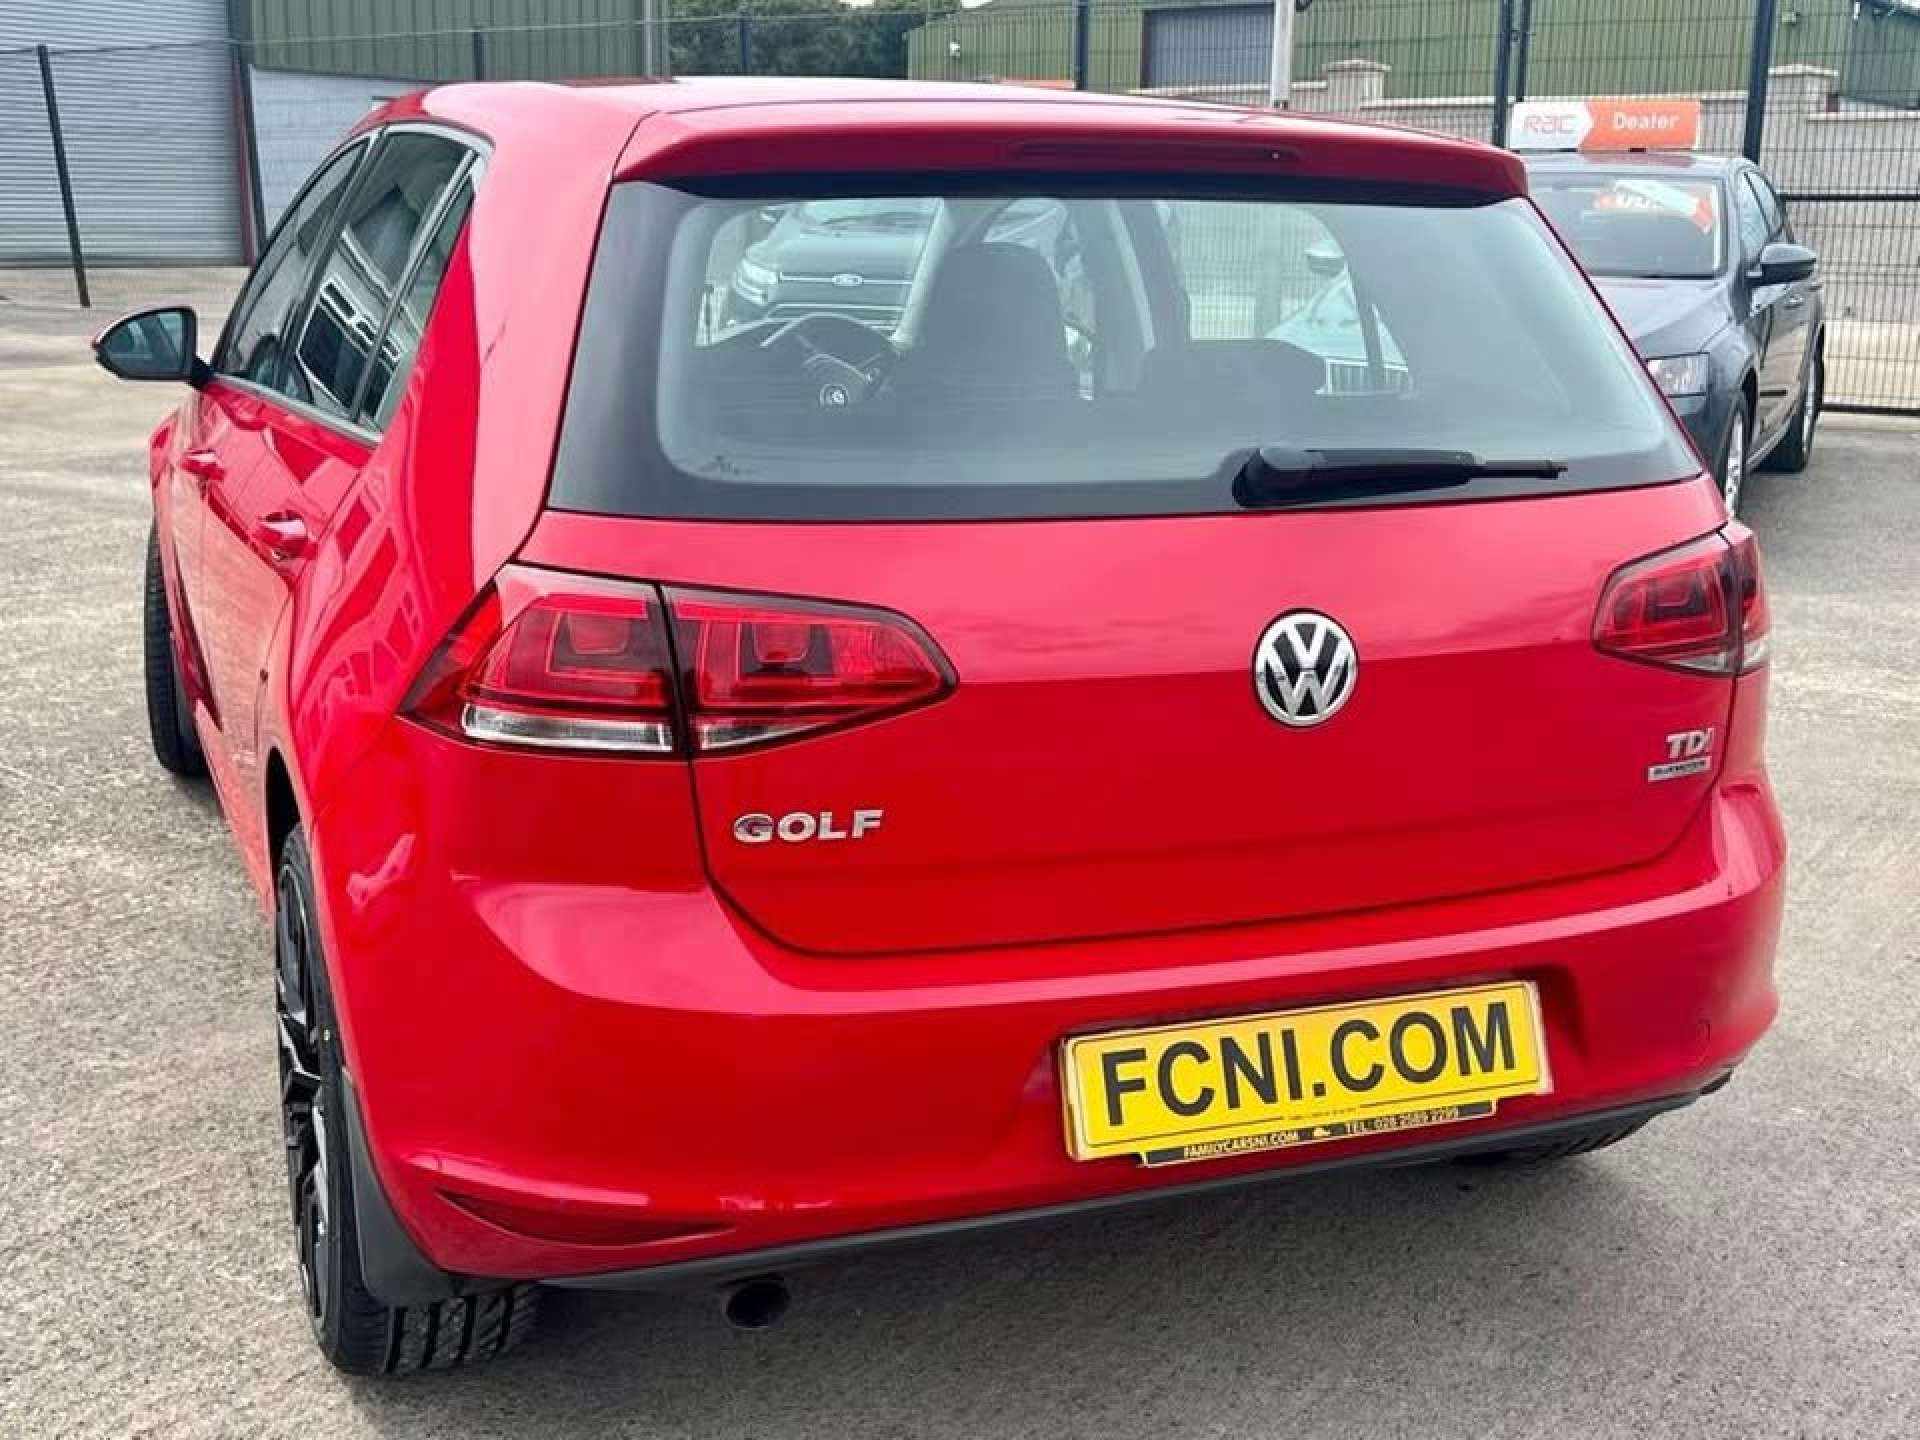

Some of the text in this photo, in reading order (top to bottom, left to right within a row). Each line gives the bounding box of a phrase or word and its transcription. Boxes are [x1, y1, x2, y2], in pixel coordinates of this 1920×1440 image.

[1614, 112, 1680, 130] Dealer
[1666, 728, 1714, 758] TDI
[734, 809, 884, 842] GOLF
[1101, 1001, 1516, 1127] FCNI.COM
